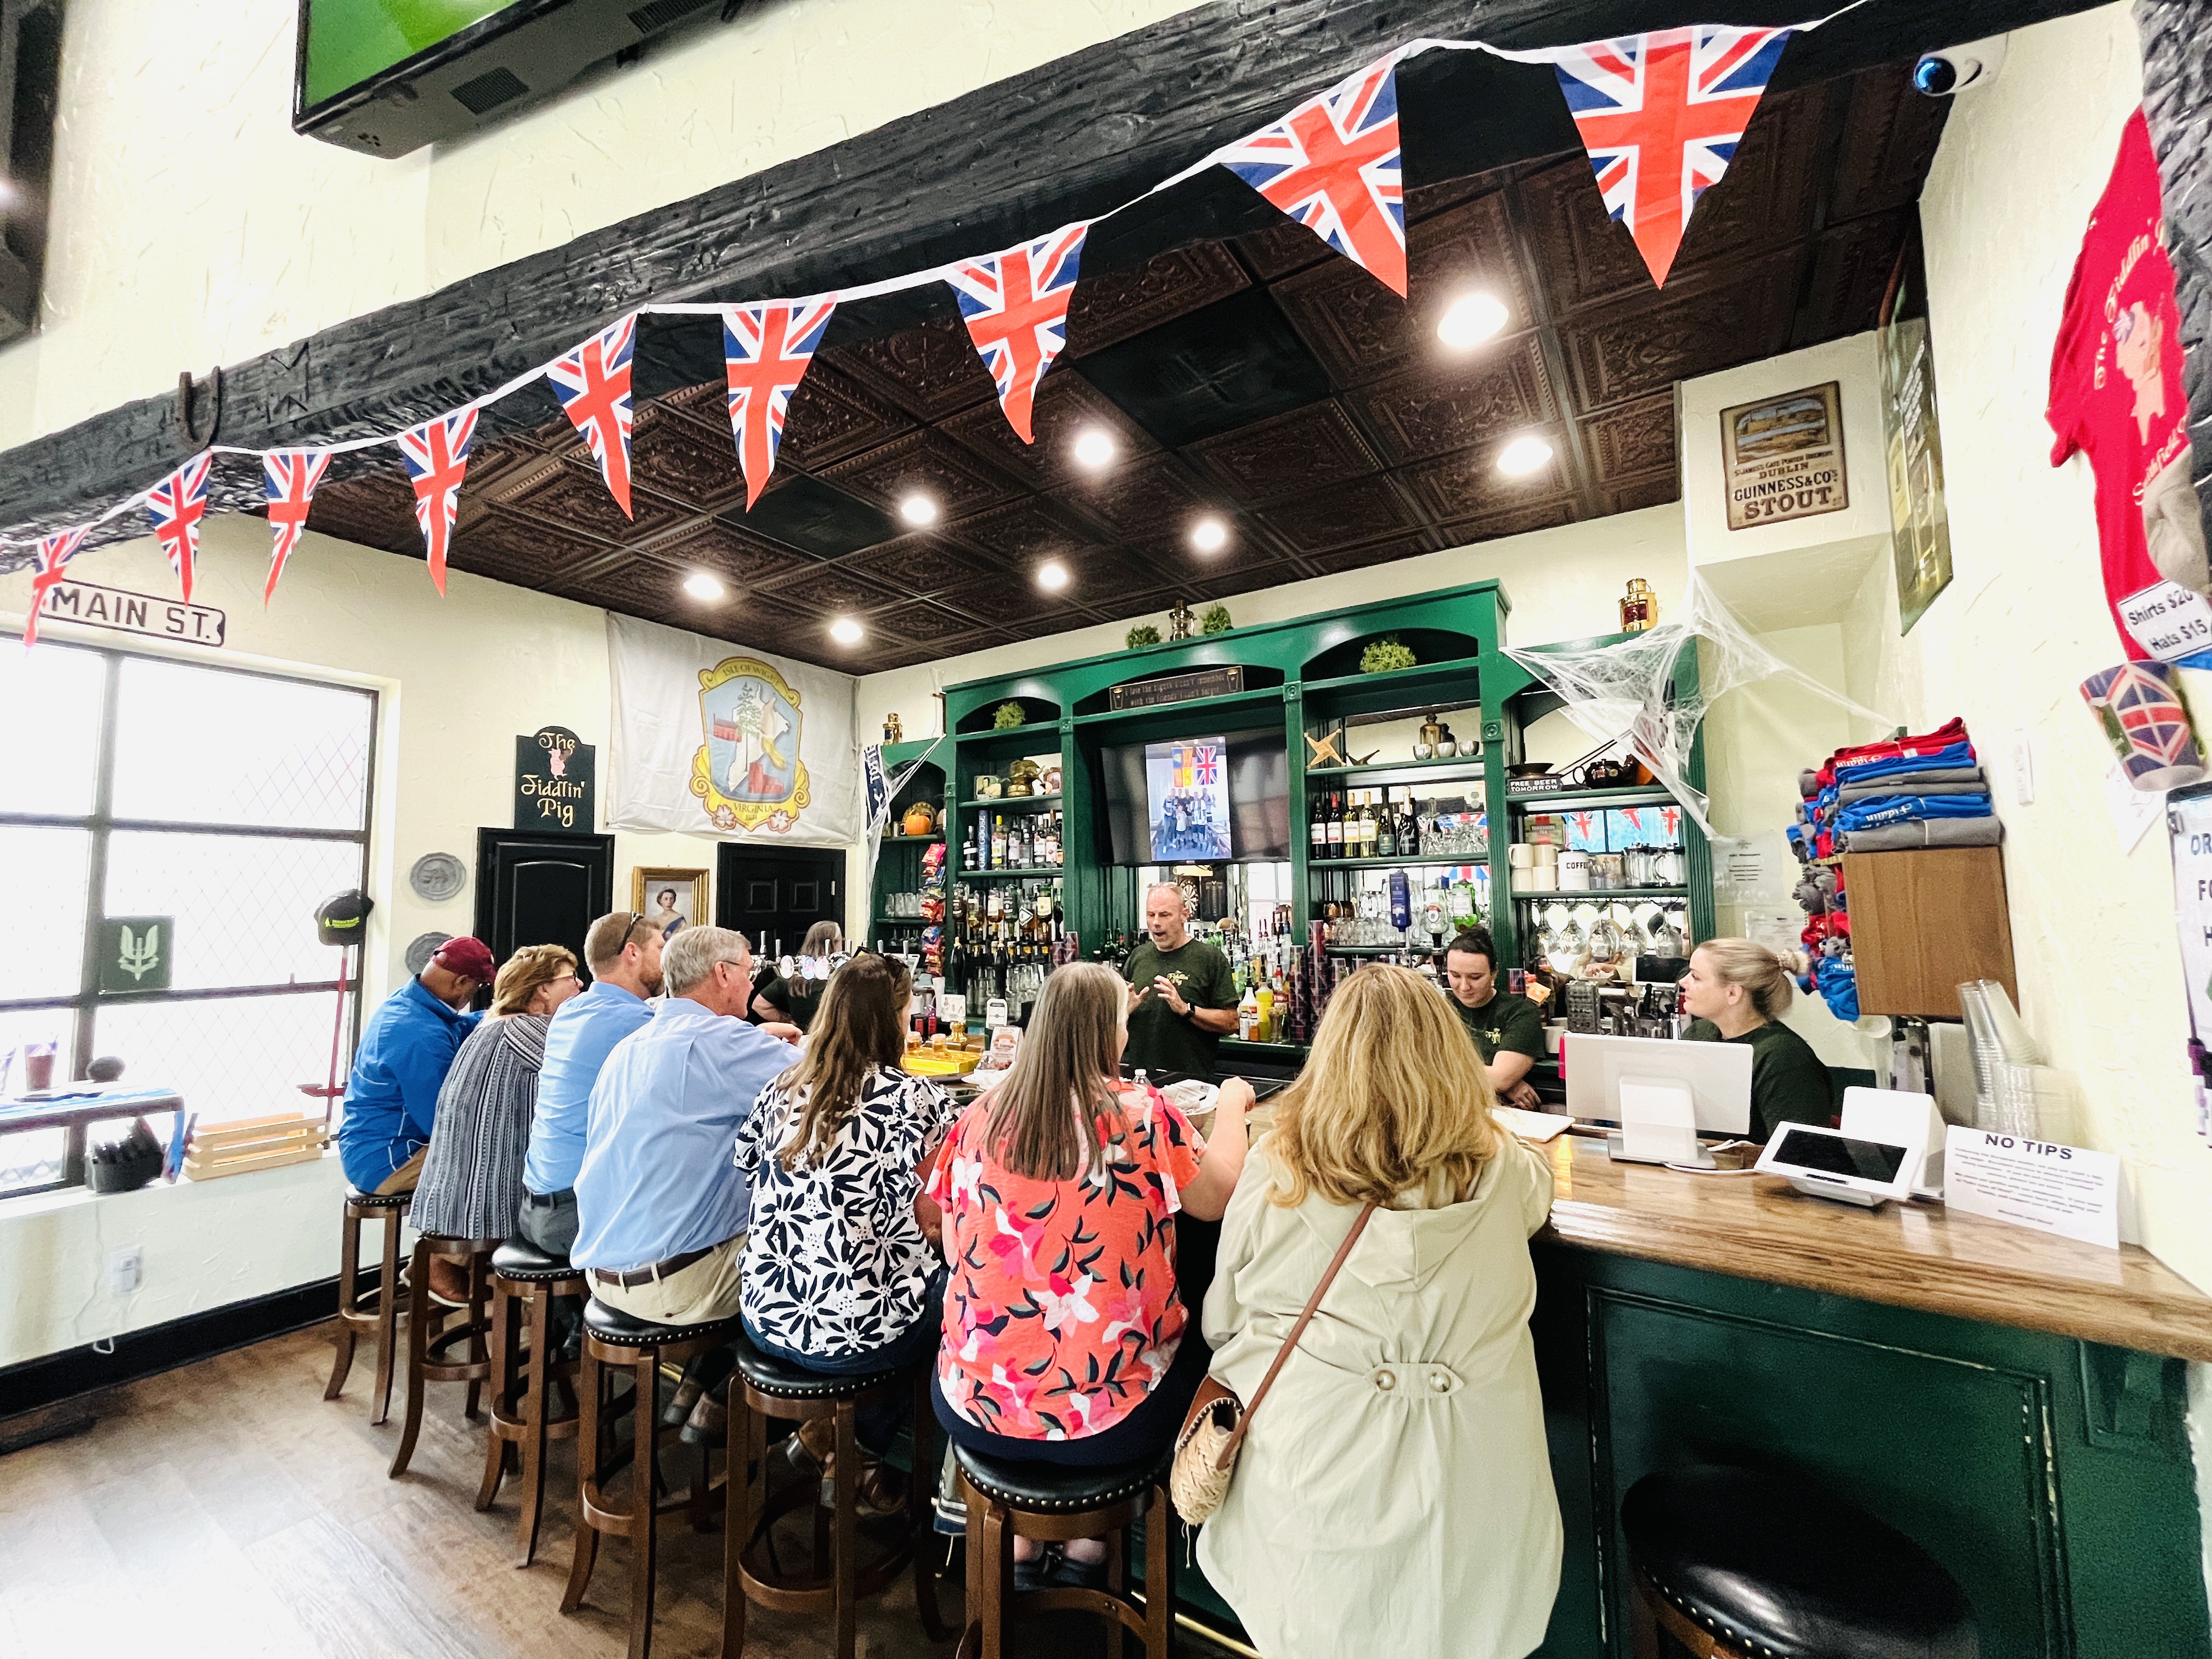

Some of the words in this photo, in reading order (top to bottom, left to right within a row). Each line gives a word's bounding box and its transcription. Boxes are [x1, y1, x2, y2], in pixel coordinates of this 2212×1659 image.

[1759, 461, 1809, 479] DUBLIN
[1743, 486, 1832, 520] STOUT
[52, 586, 148, 628] MAIN
[166, 606, 210, 639] ST.
[2128, 602, 2166, 625] Shirts
[2167, 588, 2193, 608] $20
[2148, 633, 2181, 651] Hats
[2180, 618, 2208, 640] $15
[722, 664, 739, 676] ISLE
[740, 663, 751, 672] OF
[538, 732, 575, 756] The
[521, 774, 586, 799] Fiddlin'
[537, 798, 574, 828] Pig
[733, 803, 774, 814] VIRGINIA
[1985, 1133, 2015, 1149] NO
[2023, 1140, 2073, 1160] TIPS
